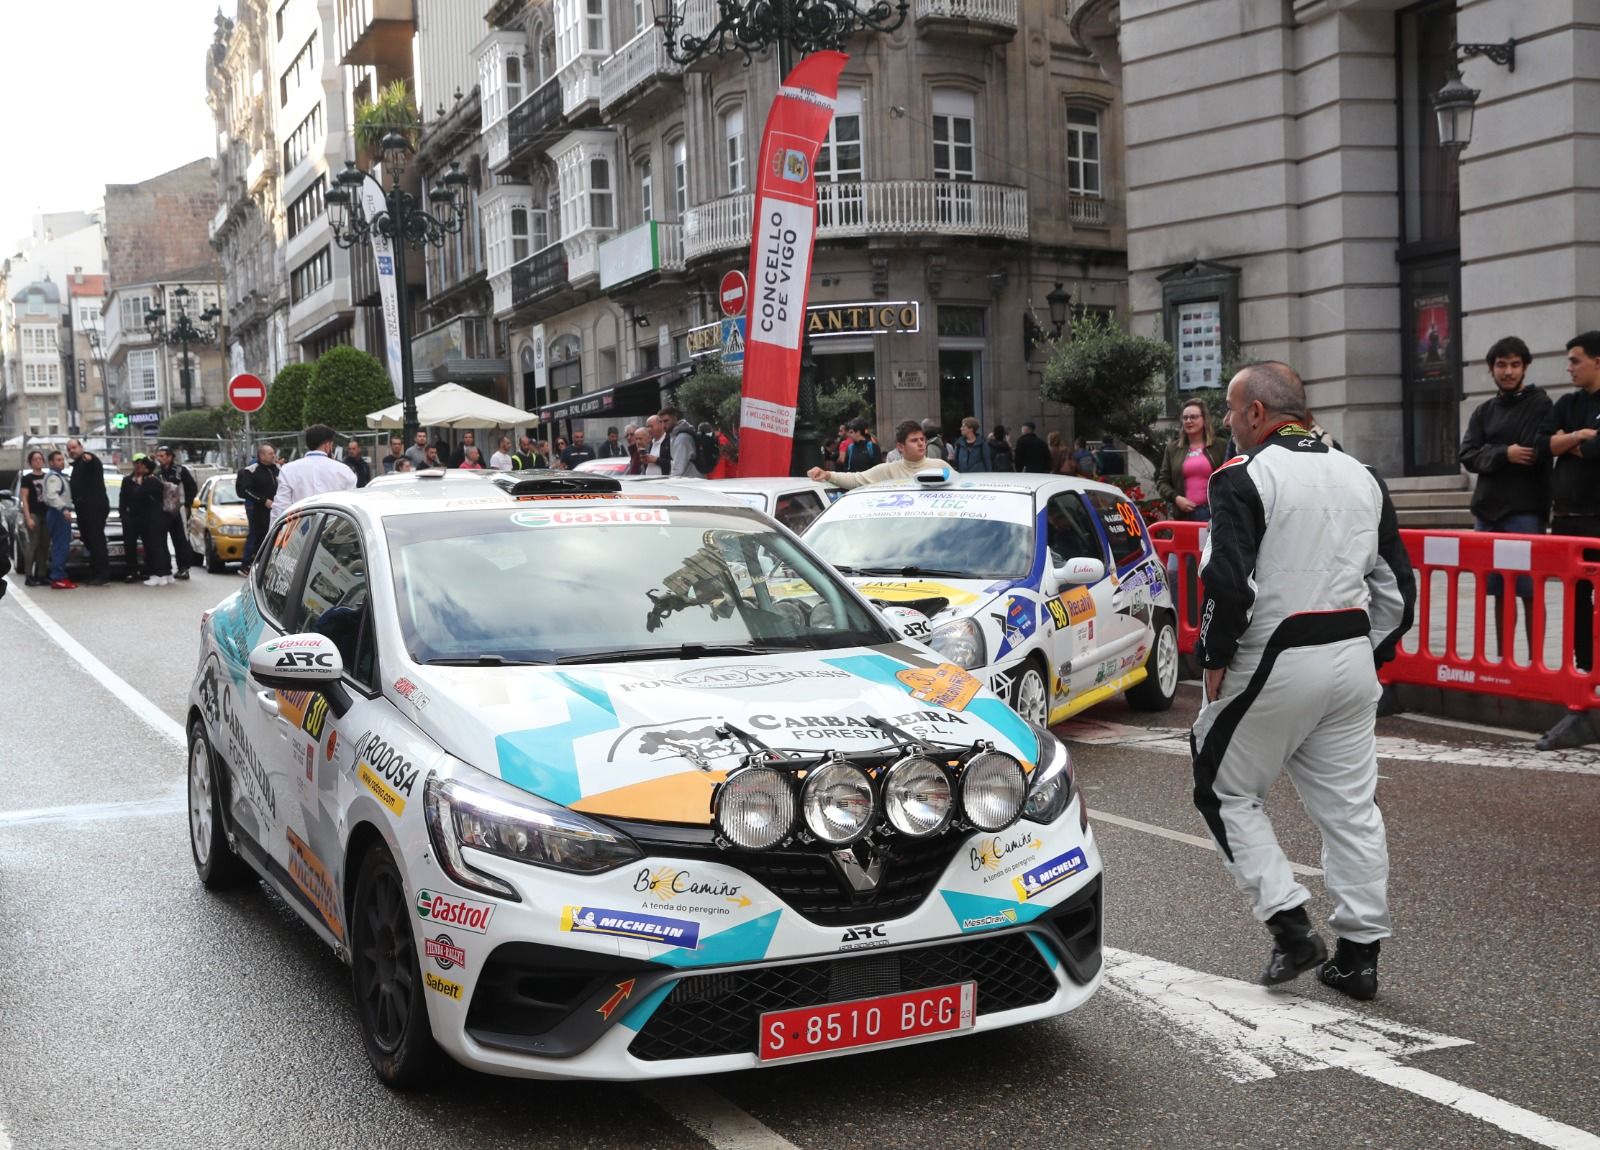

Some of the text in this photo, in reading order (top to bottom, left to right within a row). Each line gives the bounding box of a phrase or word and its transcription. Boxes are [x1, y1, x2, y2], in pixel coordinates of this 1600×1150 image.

[760, 212, 783, 332] CONCELLO
[777, 229, 797, 322] DE VIGO
[129, 413, 158, 424] FARMACIA
[918, 492, 997, 501] TRANSPORTES
[930, 499, 967, 509] LGC
[552, 509, 667, 524] Castrol
[1116, 502, 1142, 537] 98
[1049, 600, 1067, 628] 98
[280, 640, 323, 649] Castrol
[275, 652, 333, 667] ARC
[306, 694, 328, 736] 30
[792, 728, 890, 741] FORESTA
[223, 684, 276, 819] CARBALLEIRA
[363, 734, 420, 798] RODOSA
[1039, 855, 1081, 883] MICHELIN
[633, 868, 741, 897] Bo Camiño
[432, 896, 490, 930] Castrol
[650, 902, 674, 911] tenda
[676, 904, 687, 912] do
[689, 907, 730, 916] peregrino
[599, 917, 684, 938] MICHELIN
[841, 923, 887, 943] ARC
[963, 915, 1006, 928] MessDraw
[426, 973, 460, 999] Sabelt
[769, 997, 953, 1050] S 8510 BCG
[961, 1009, 971, 1019] 23
